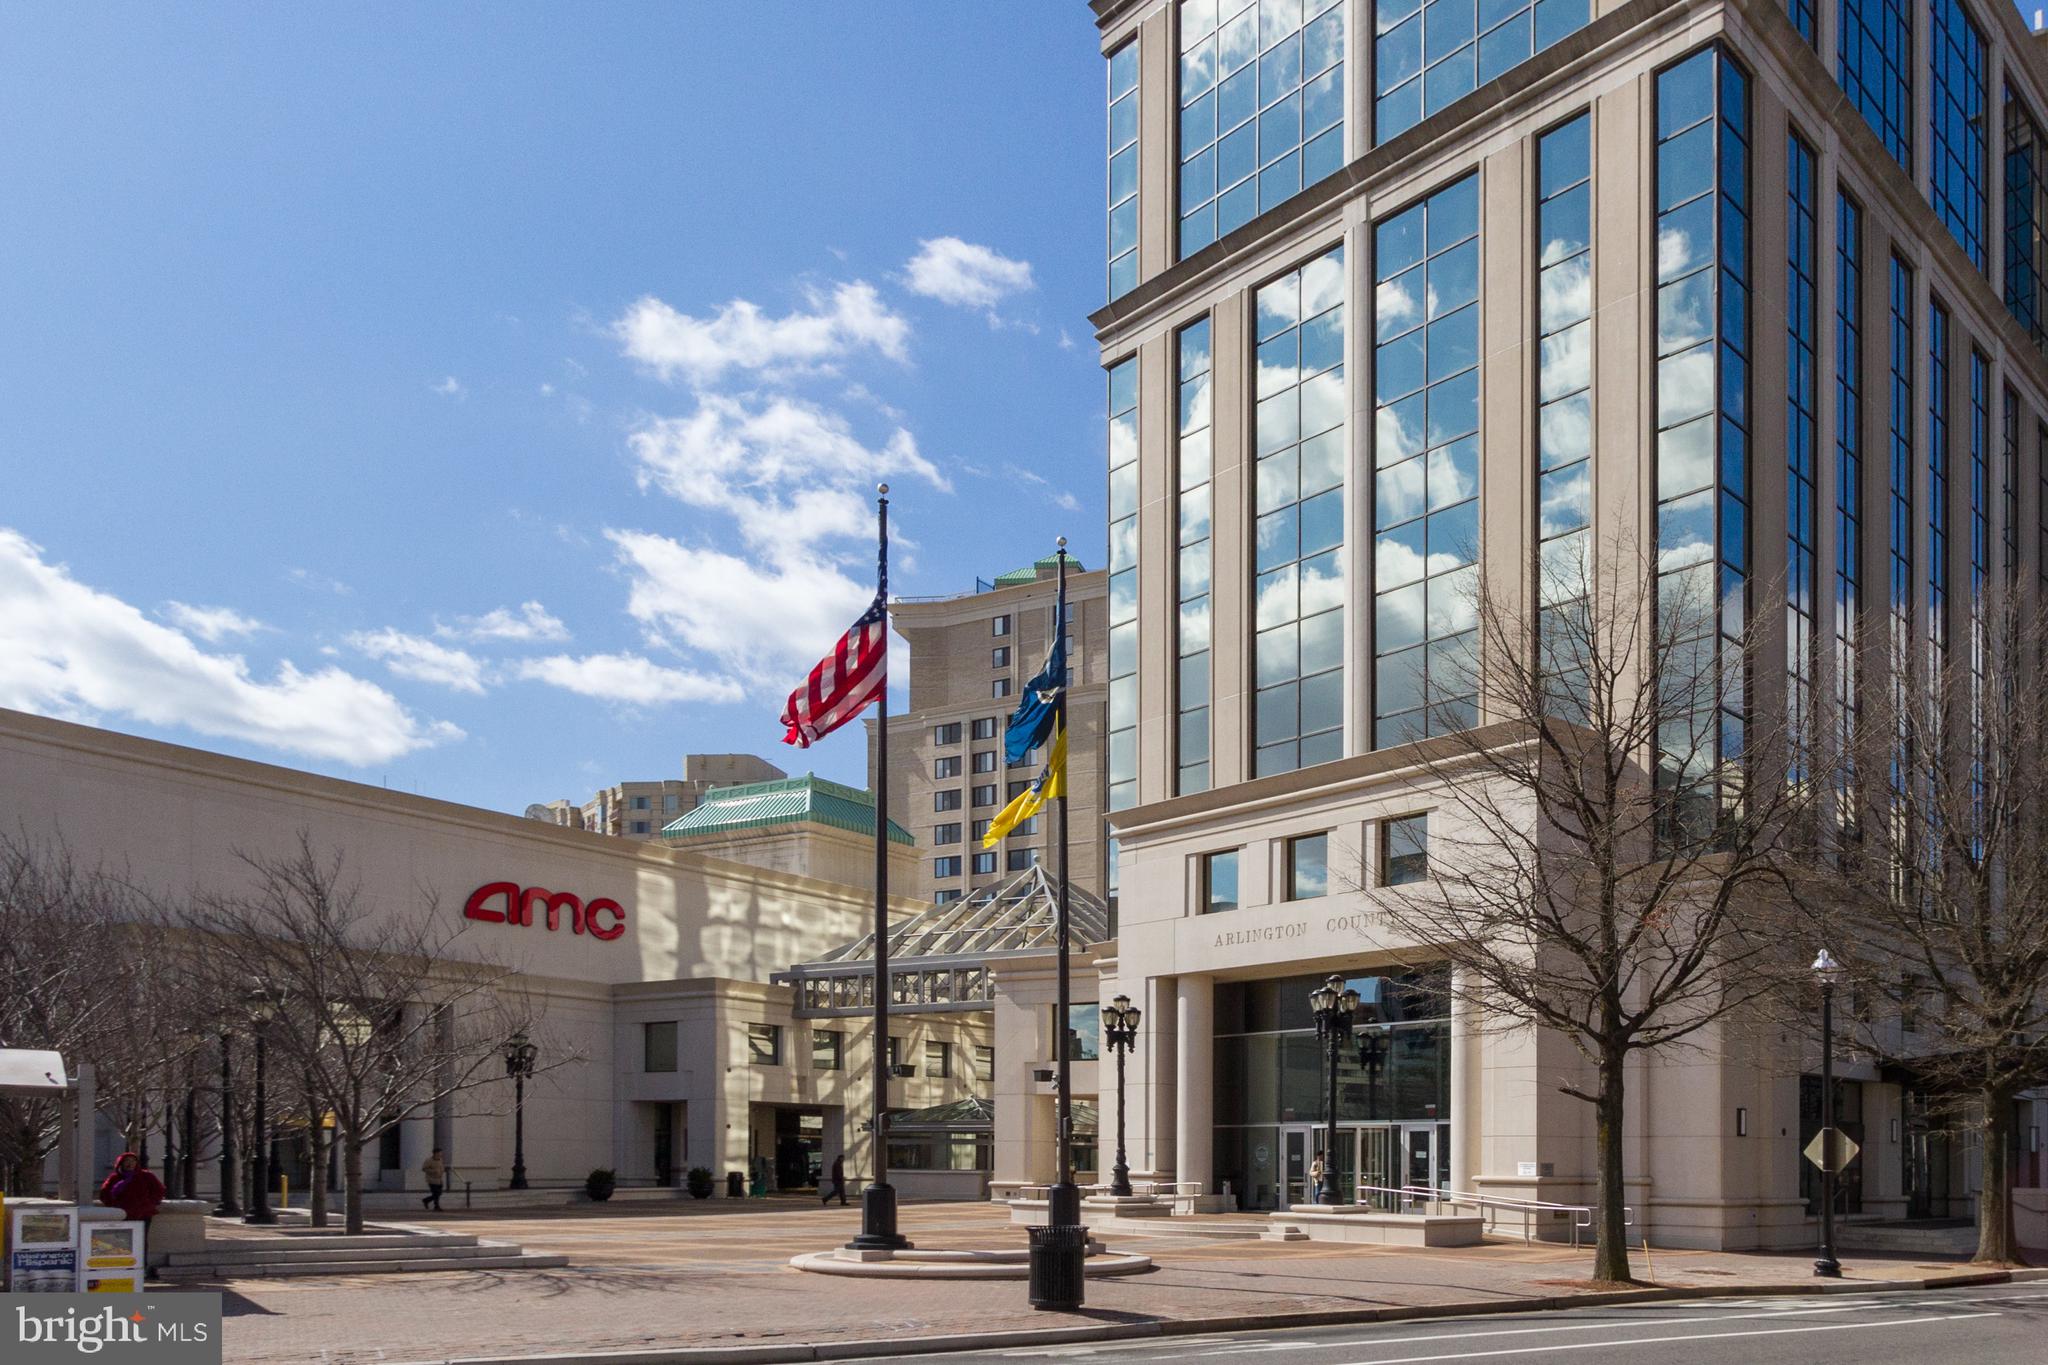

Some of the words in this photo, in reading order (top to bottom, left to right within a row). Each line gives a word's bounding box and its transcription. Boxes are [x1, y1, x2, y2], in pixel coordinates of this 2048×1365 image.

[464, 882, 625, 941] amc
[1214, 922, 1307, 947] ARLINGTON
[18, 1256, 73, 1266] Hispanic
